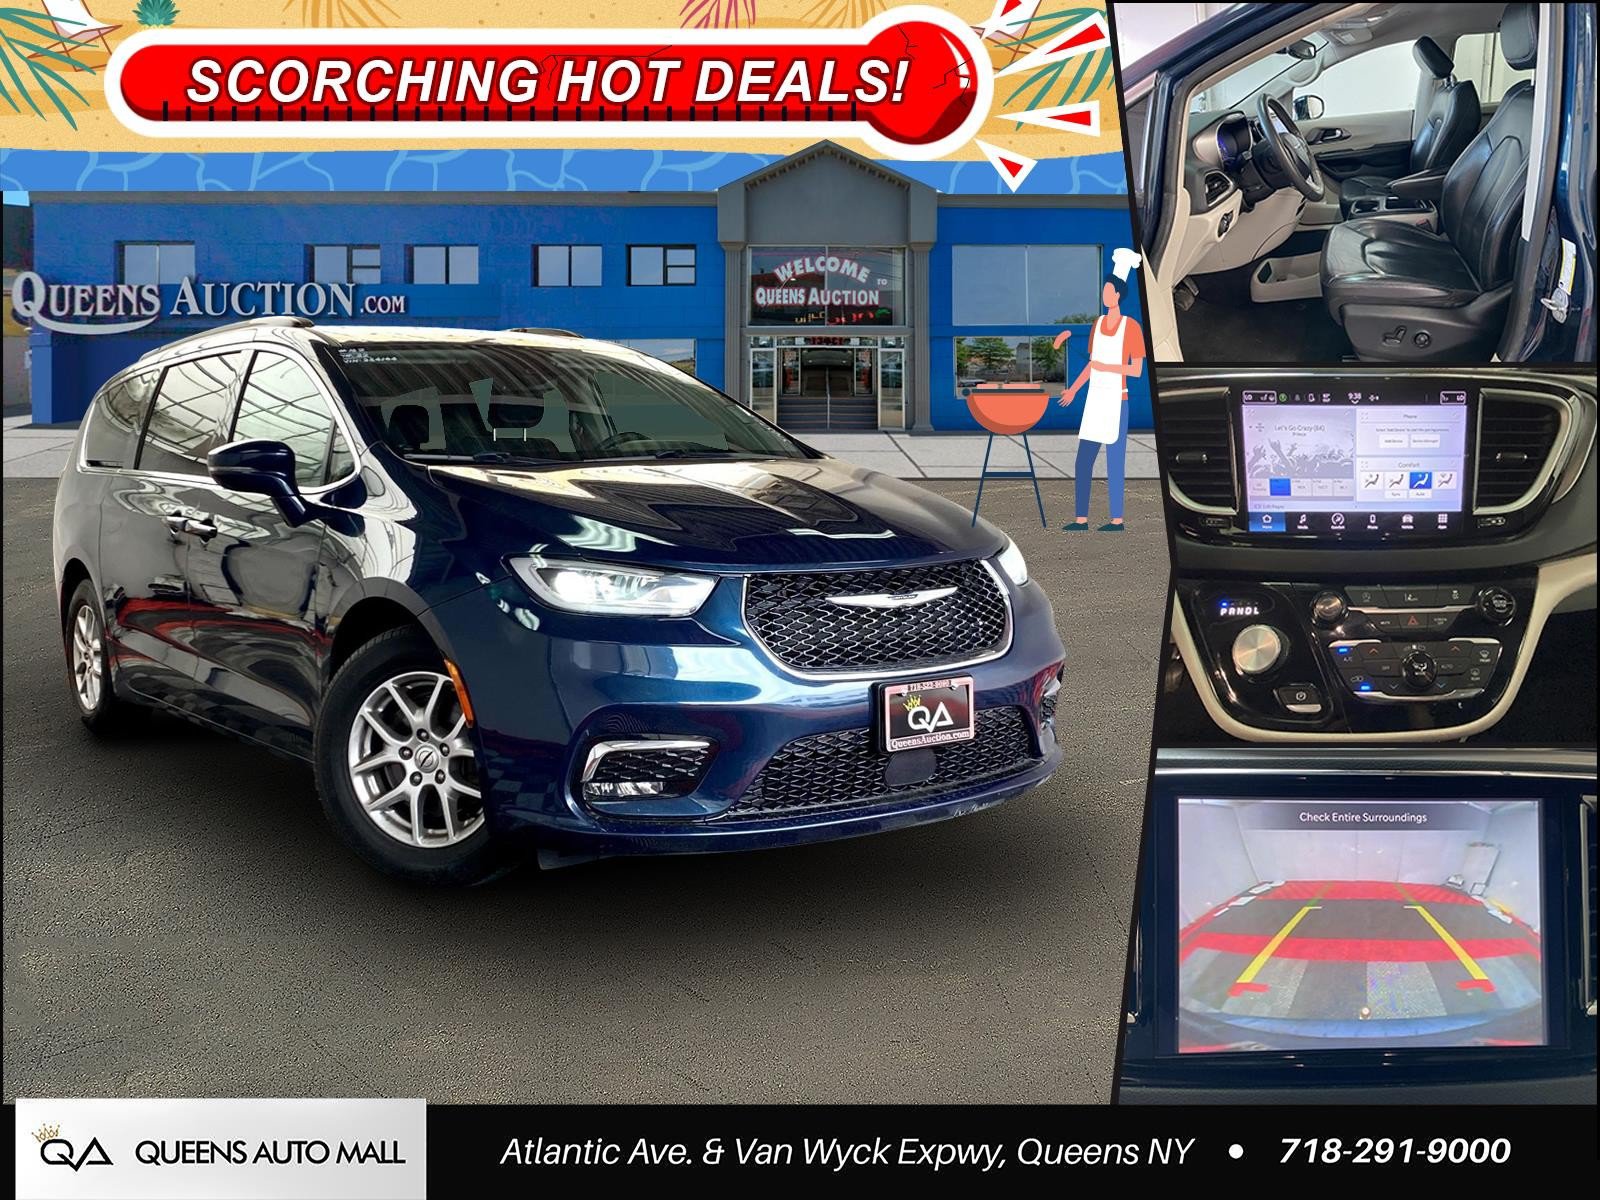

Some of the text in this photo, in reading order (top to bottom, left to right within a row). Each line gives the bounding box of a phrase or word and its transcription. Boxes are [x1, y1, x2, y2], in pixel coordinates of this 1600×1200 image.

[773, 255, 888, 286] WELCOME TO
[169, 276, 356, 317] AUCTION
[755, 286, 880, 307] QUEENS AUCTION
[907, 701, 954, 733] QA
[890, 730, 971, 750] QueensAuction.com
[1299, 811, 1428, 825] Check Entire Surroundings
